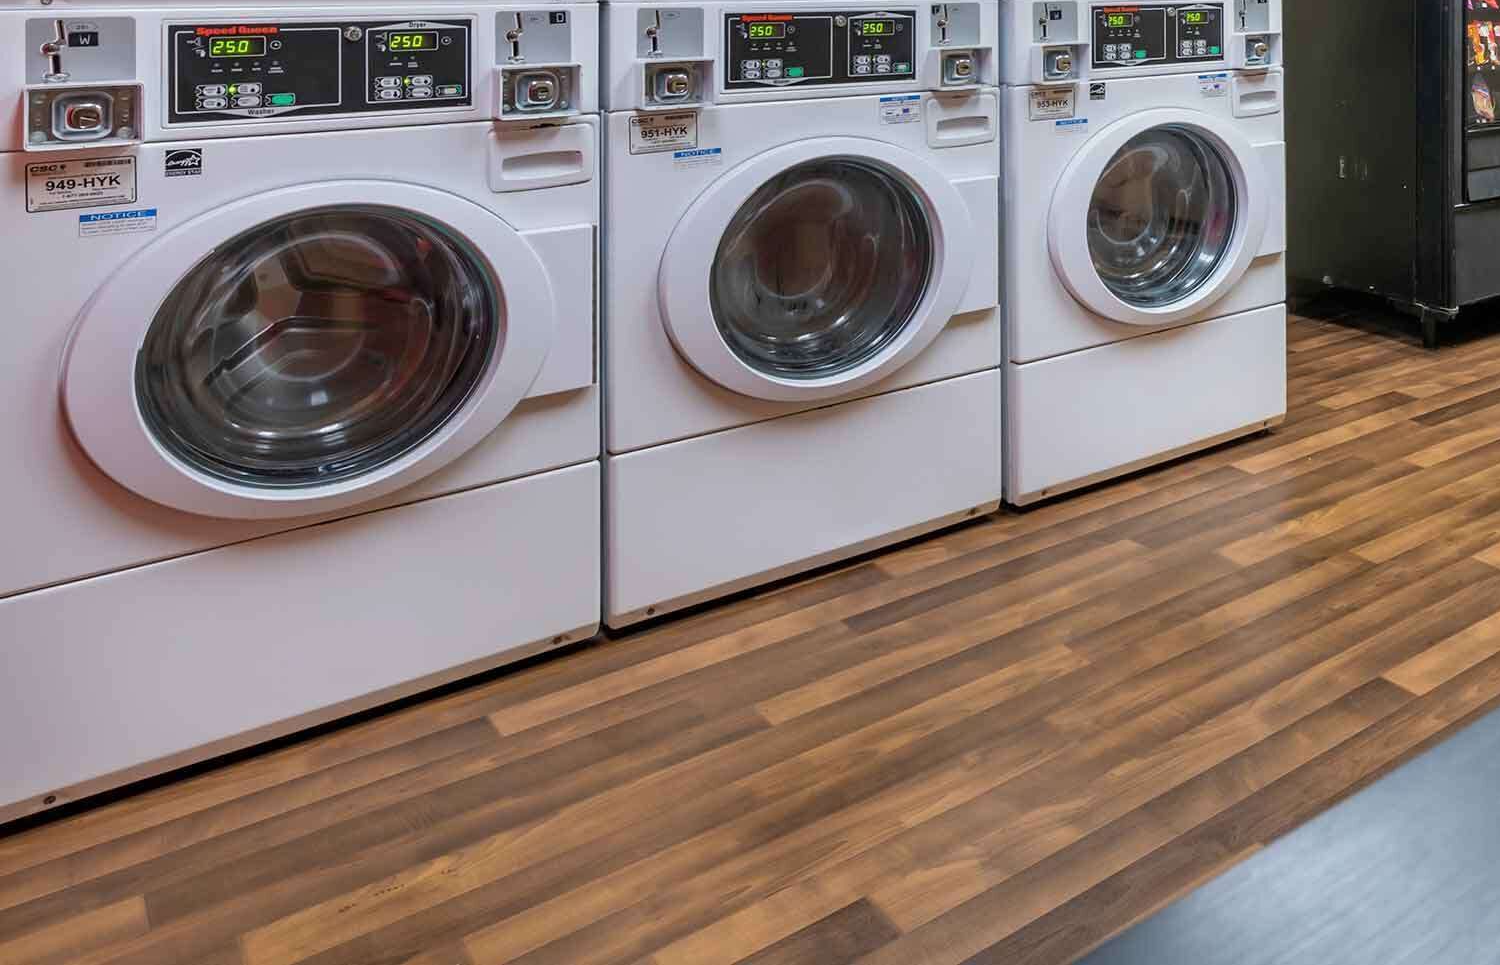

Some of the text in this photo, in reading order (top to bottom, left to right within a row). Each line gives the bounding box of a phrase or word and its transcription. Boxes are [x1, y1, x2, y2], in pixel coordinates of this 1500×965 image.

[196, 25, 278, 36] Speed Queen
[750, 25, 773, 37] 250
[863, 22, 883, 33] 250
[80, 35, 91, 45] W
[390, 35, 423, 48] 250
[212, 40, 249, 54] 250
[248, 108, 275, 117] Washer
[640, 126, 688, 138] 951-HYK
[30, 165, 58, 173] CSC
[45, 174, 121, 192] 949-HYK
[89, 209, 146, 221] NOTICE
